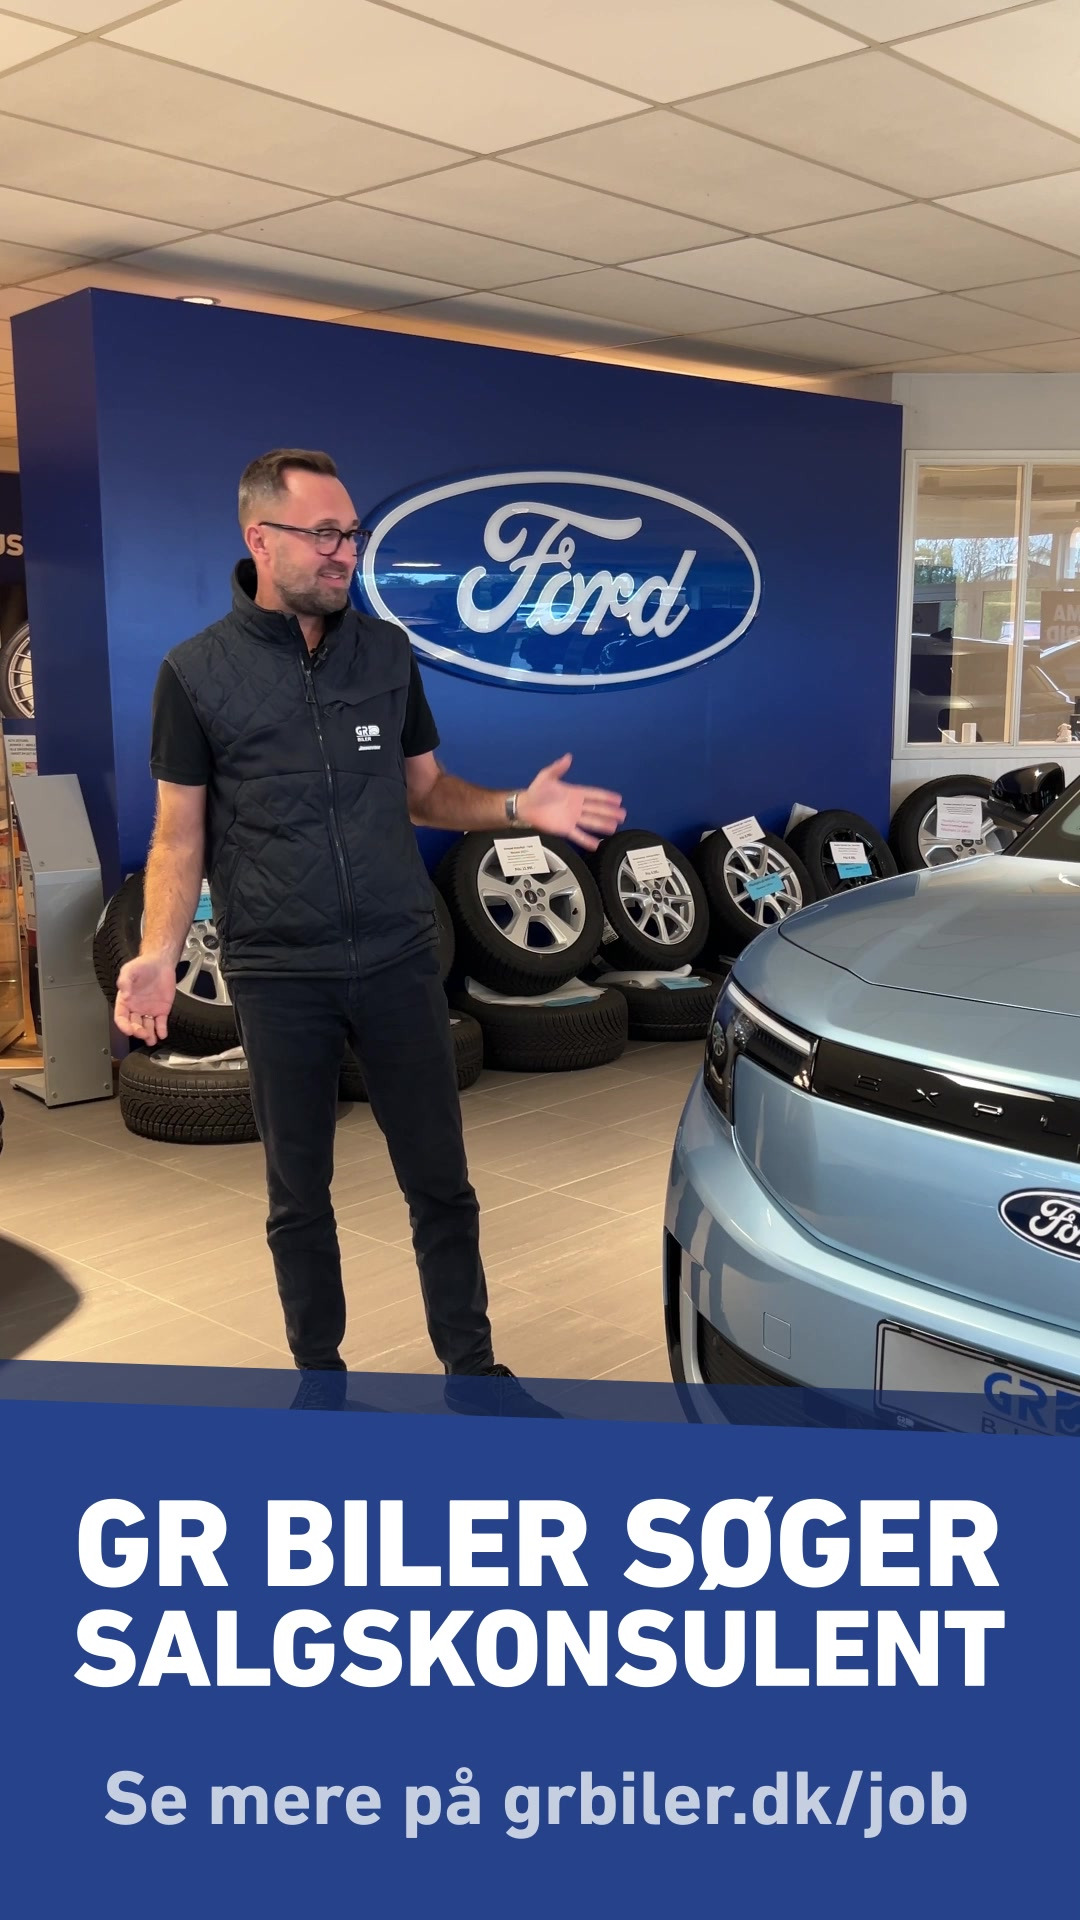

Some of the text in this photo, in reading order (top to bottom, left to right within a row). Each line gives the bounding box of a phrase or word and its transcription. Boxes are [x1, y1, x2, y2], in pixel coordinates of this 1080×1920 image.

[457, 501, 697, 638] Ford
[1028, 1199, 1080, 1247] Fo
[983, 1371, 1049, 1429] GR
